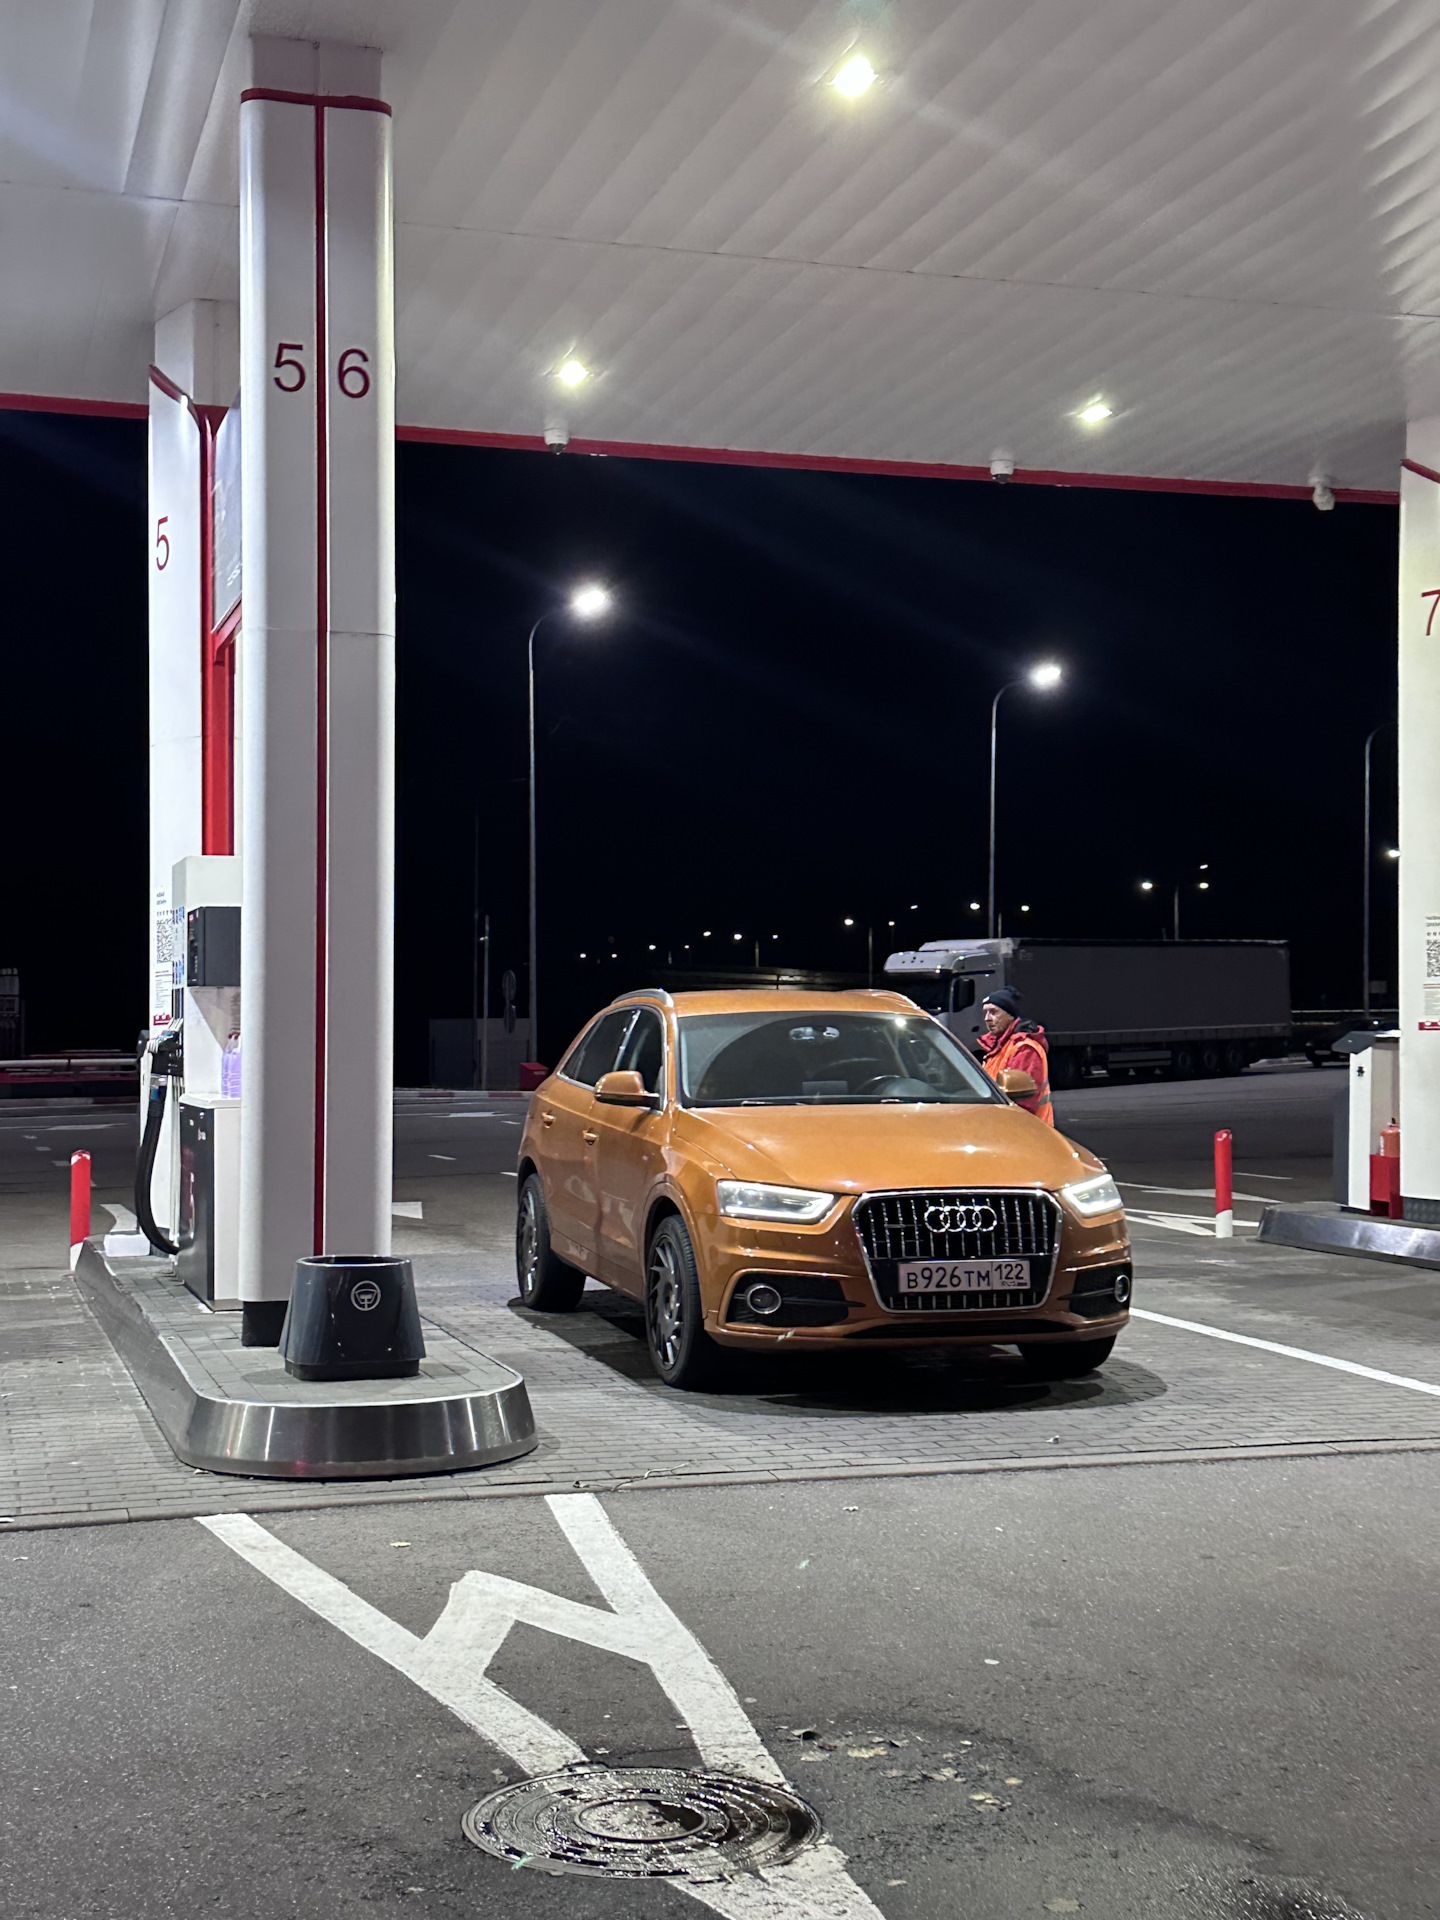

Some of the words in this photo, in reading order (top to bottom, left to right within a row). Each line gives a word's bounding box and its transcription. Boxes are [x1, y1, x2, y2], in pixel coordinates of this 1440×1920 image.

[274, 343, 306, 392] 5
[338, 348, 370, 399] 6
[156, 516, 170, 571] 5
[1421, 589, 1440, 636] 7
[994, 1263, 1024, 1280] 122
